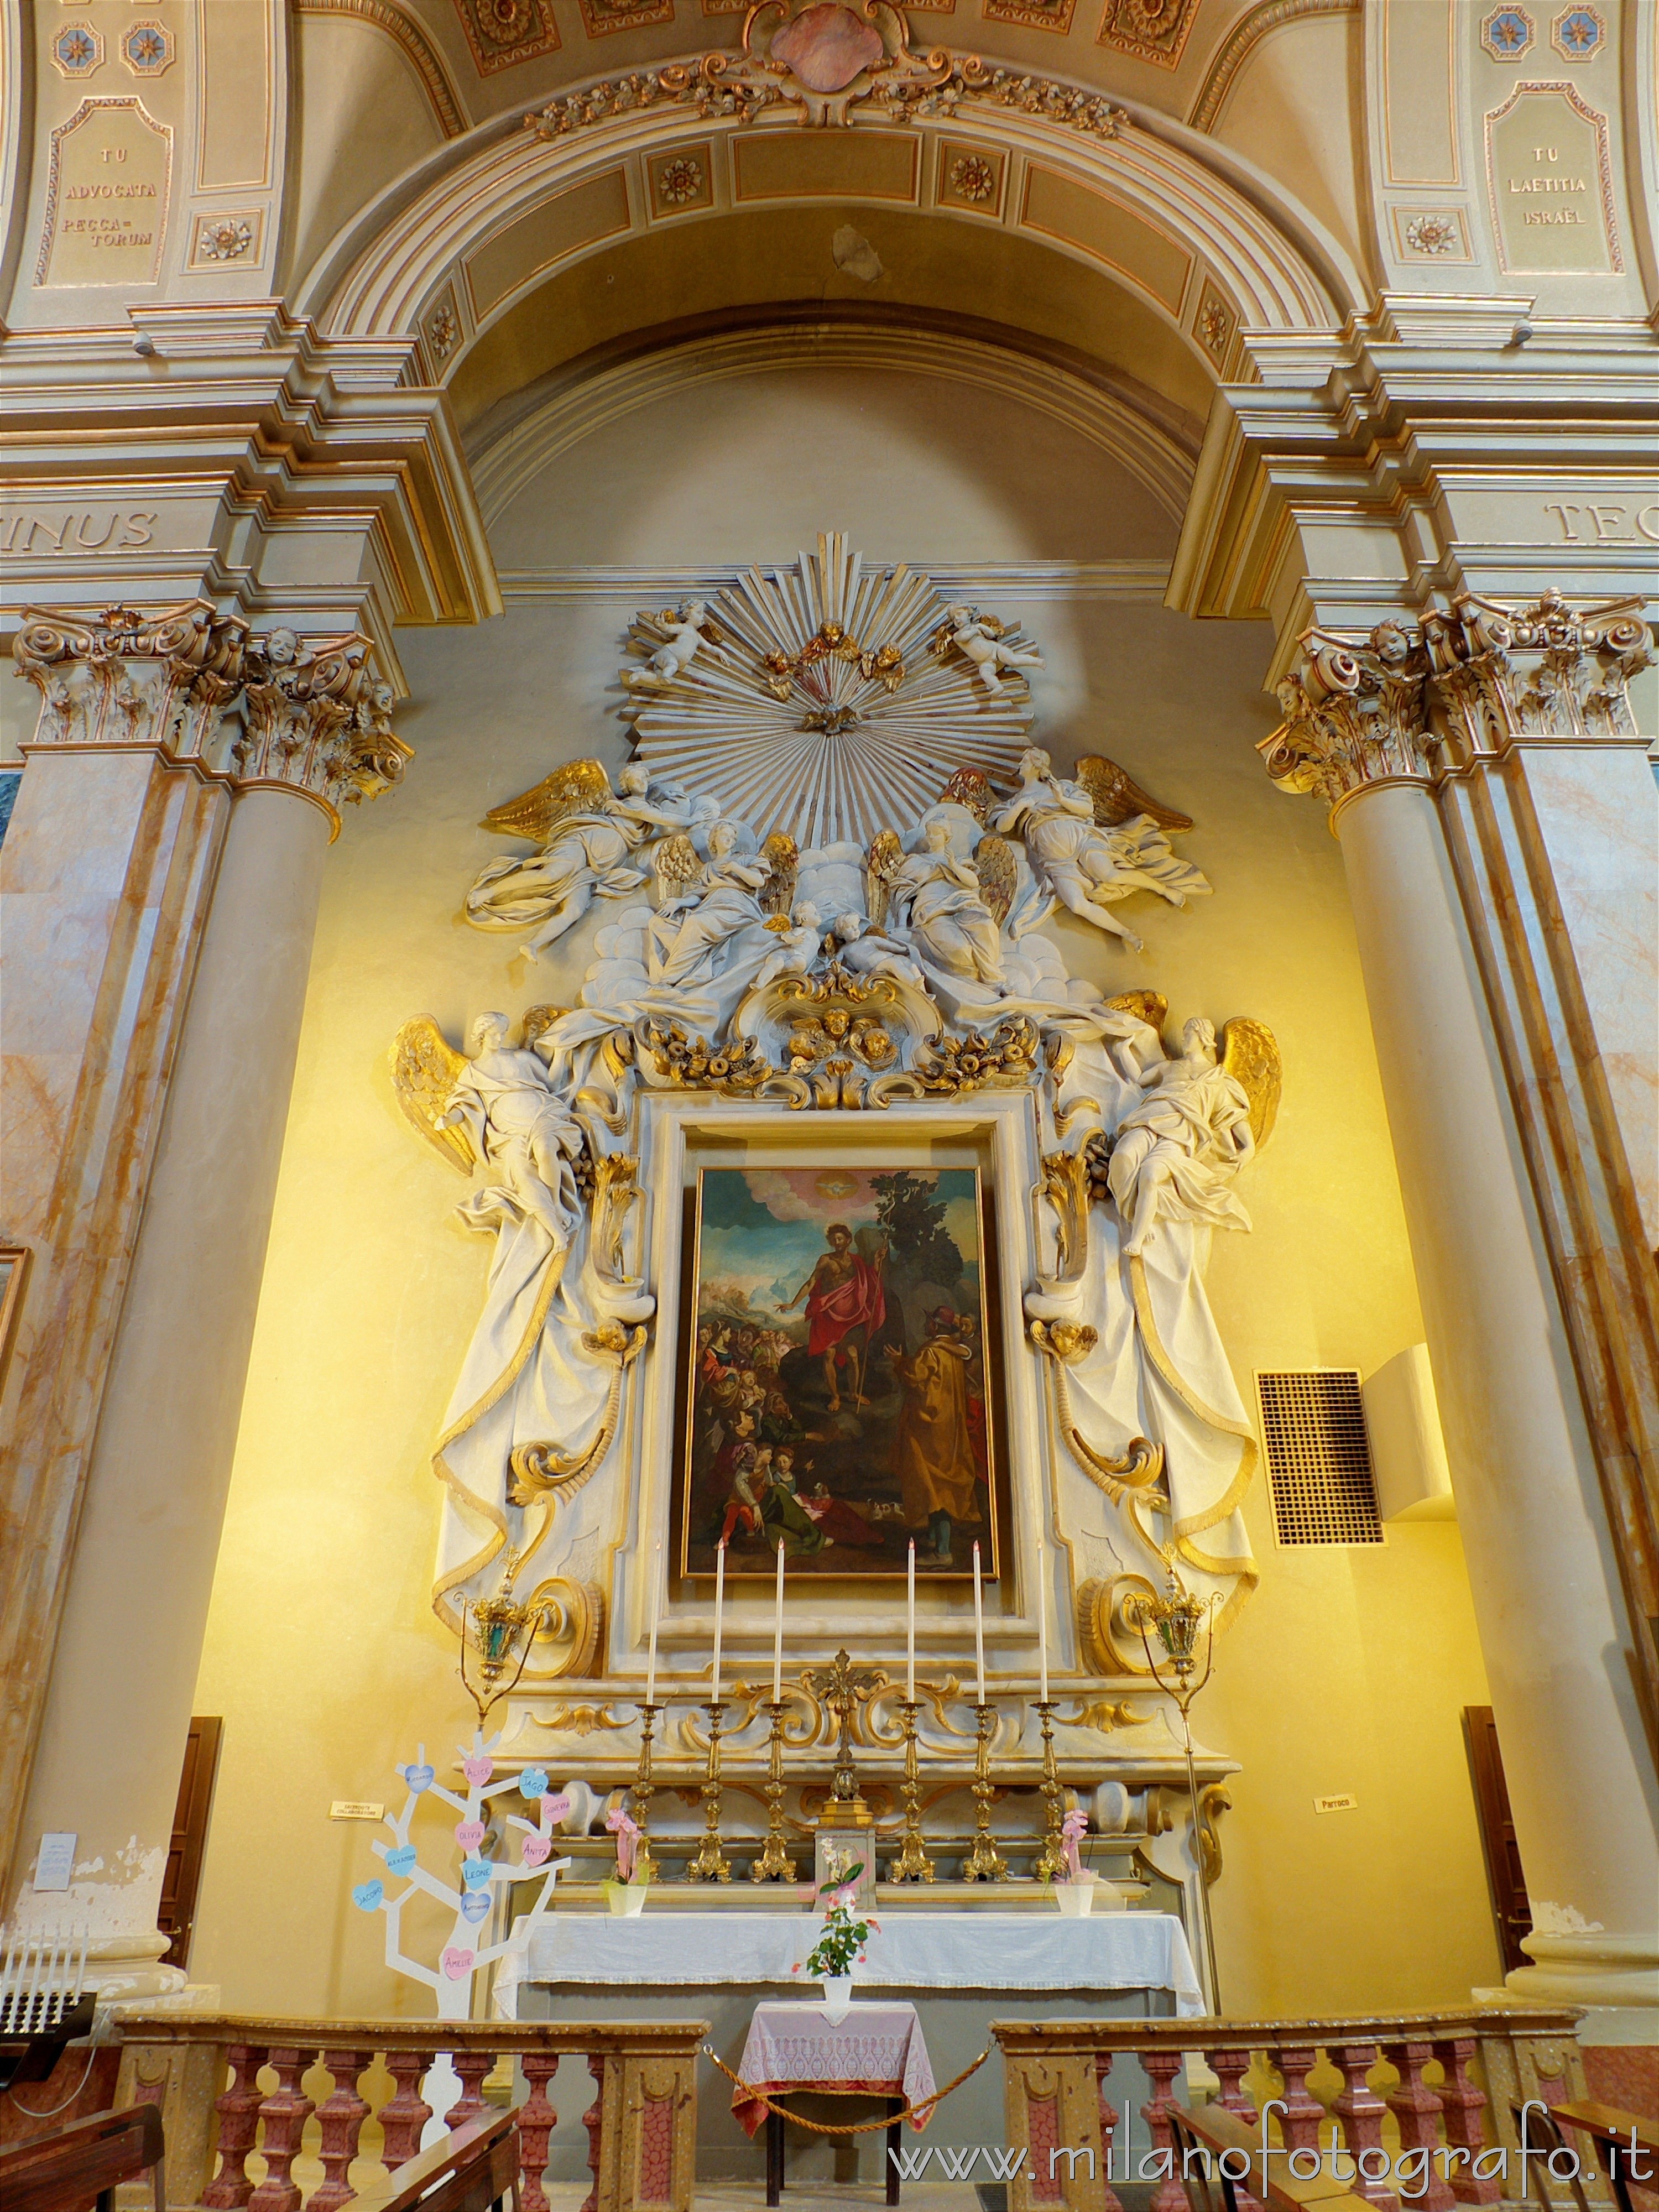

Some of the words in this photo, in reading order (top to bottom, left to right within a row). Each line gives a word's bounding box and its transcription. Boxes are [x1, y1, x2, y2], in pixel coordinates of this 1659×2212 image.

[101, 149, 127, 163] TU
[1532, 148, 1558, 162] TU
[65, 183, 156, 199] ADVOCATA
[1508, 178, 1586, 193] LAETITIA
[1524, 207, 1587, 225] ISRAËL
[92, 233, 152, 247] TORUM
[0, 513, 157, 551] INUS
[467, 1767, 490, 1777] ALICE
[522, 1776, 544, 1792] JAGO
[1322, 1799, 1350, 1809] Parroco
[524, 1844, 547, 1857] ANITA
[465, 1868, 490, 1880] LEONE
[354, 1886, 383, 1906] JACOPO
[445, 1957, 472, 1968] AMELIE
